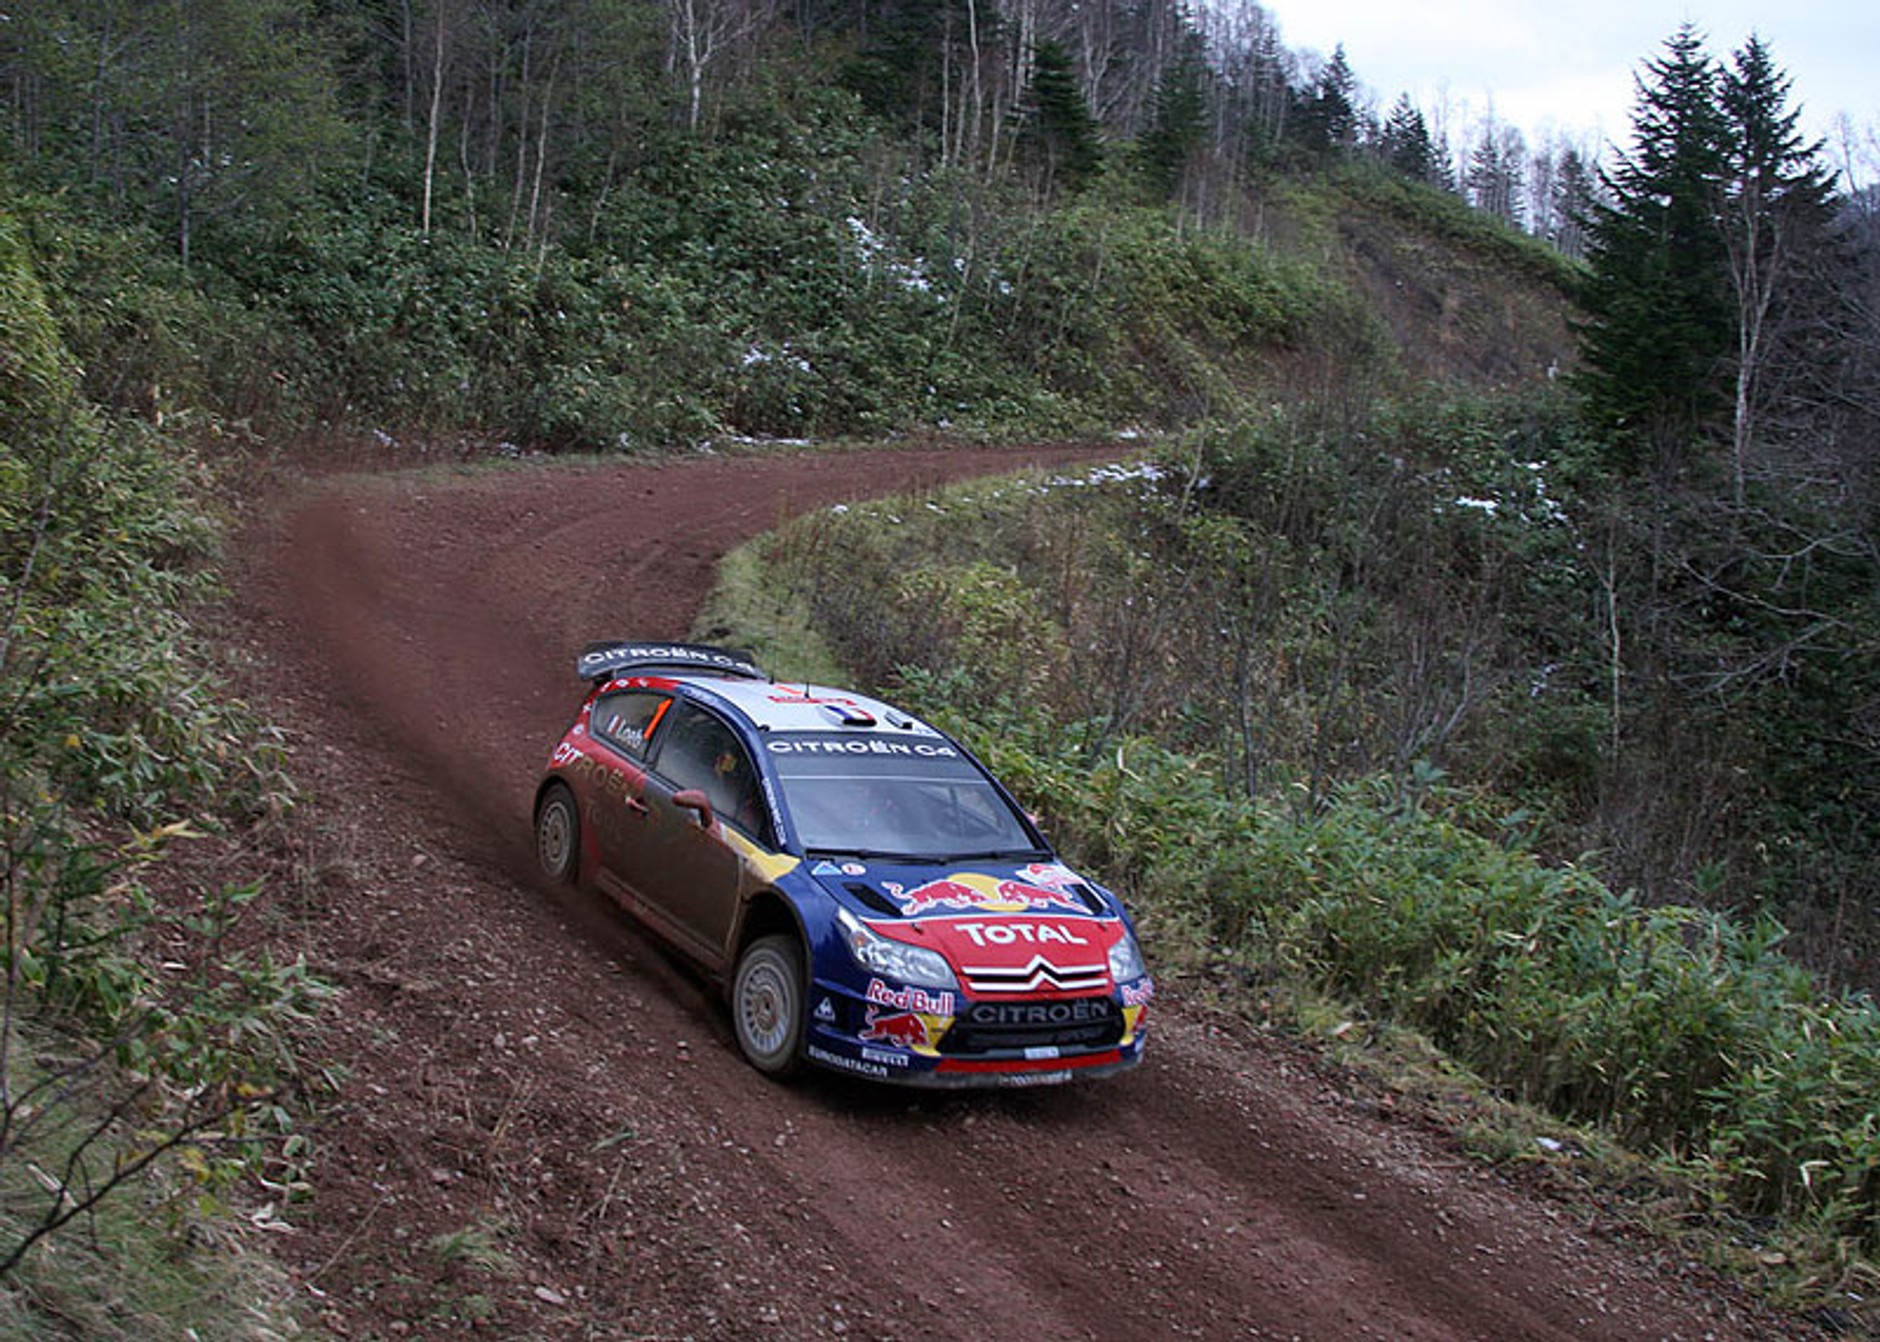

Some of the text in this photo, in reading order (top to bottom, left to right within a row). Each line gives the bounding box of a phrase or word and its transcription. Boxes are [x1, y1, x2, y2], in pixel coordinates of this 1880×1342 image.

[642, 698, 674, 742] 1
[766, 739, 958, 759] CITROËN C4
[553, 741, 631, 798] CITROË
[954, 922, 1090, 947] TOTAL
[867, 977, 955, 1017] Red Bull
[973, 997, 1109, 1023] CITROËN
